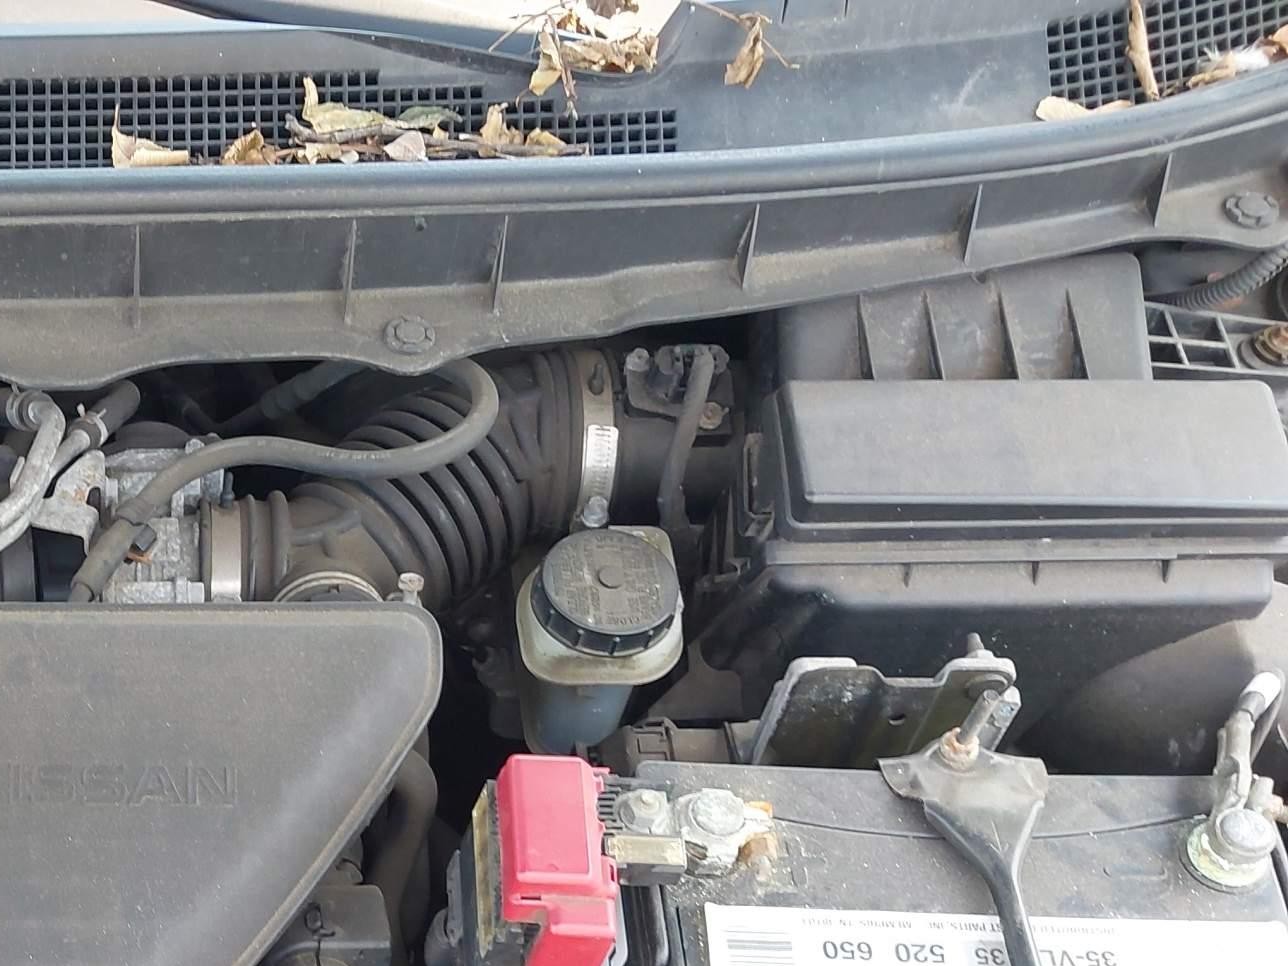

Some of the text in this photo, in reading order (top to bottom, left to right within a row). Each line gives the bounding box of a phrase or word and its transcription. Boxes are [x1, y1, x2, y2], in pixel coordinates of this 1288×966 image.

[822, 939, 873, 961] 650
[895, 943, 945, 963] 520
[974, 947, 1006, 966] 35
